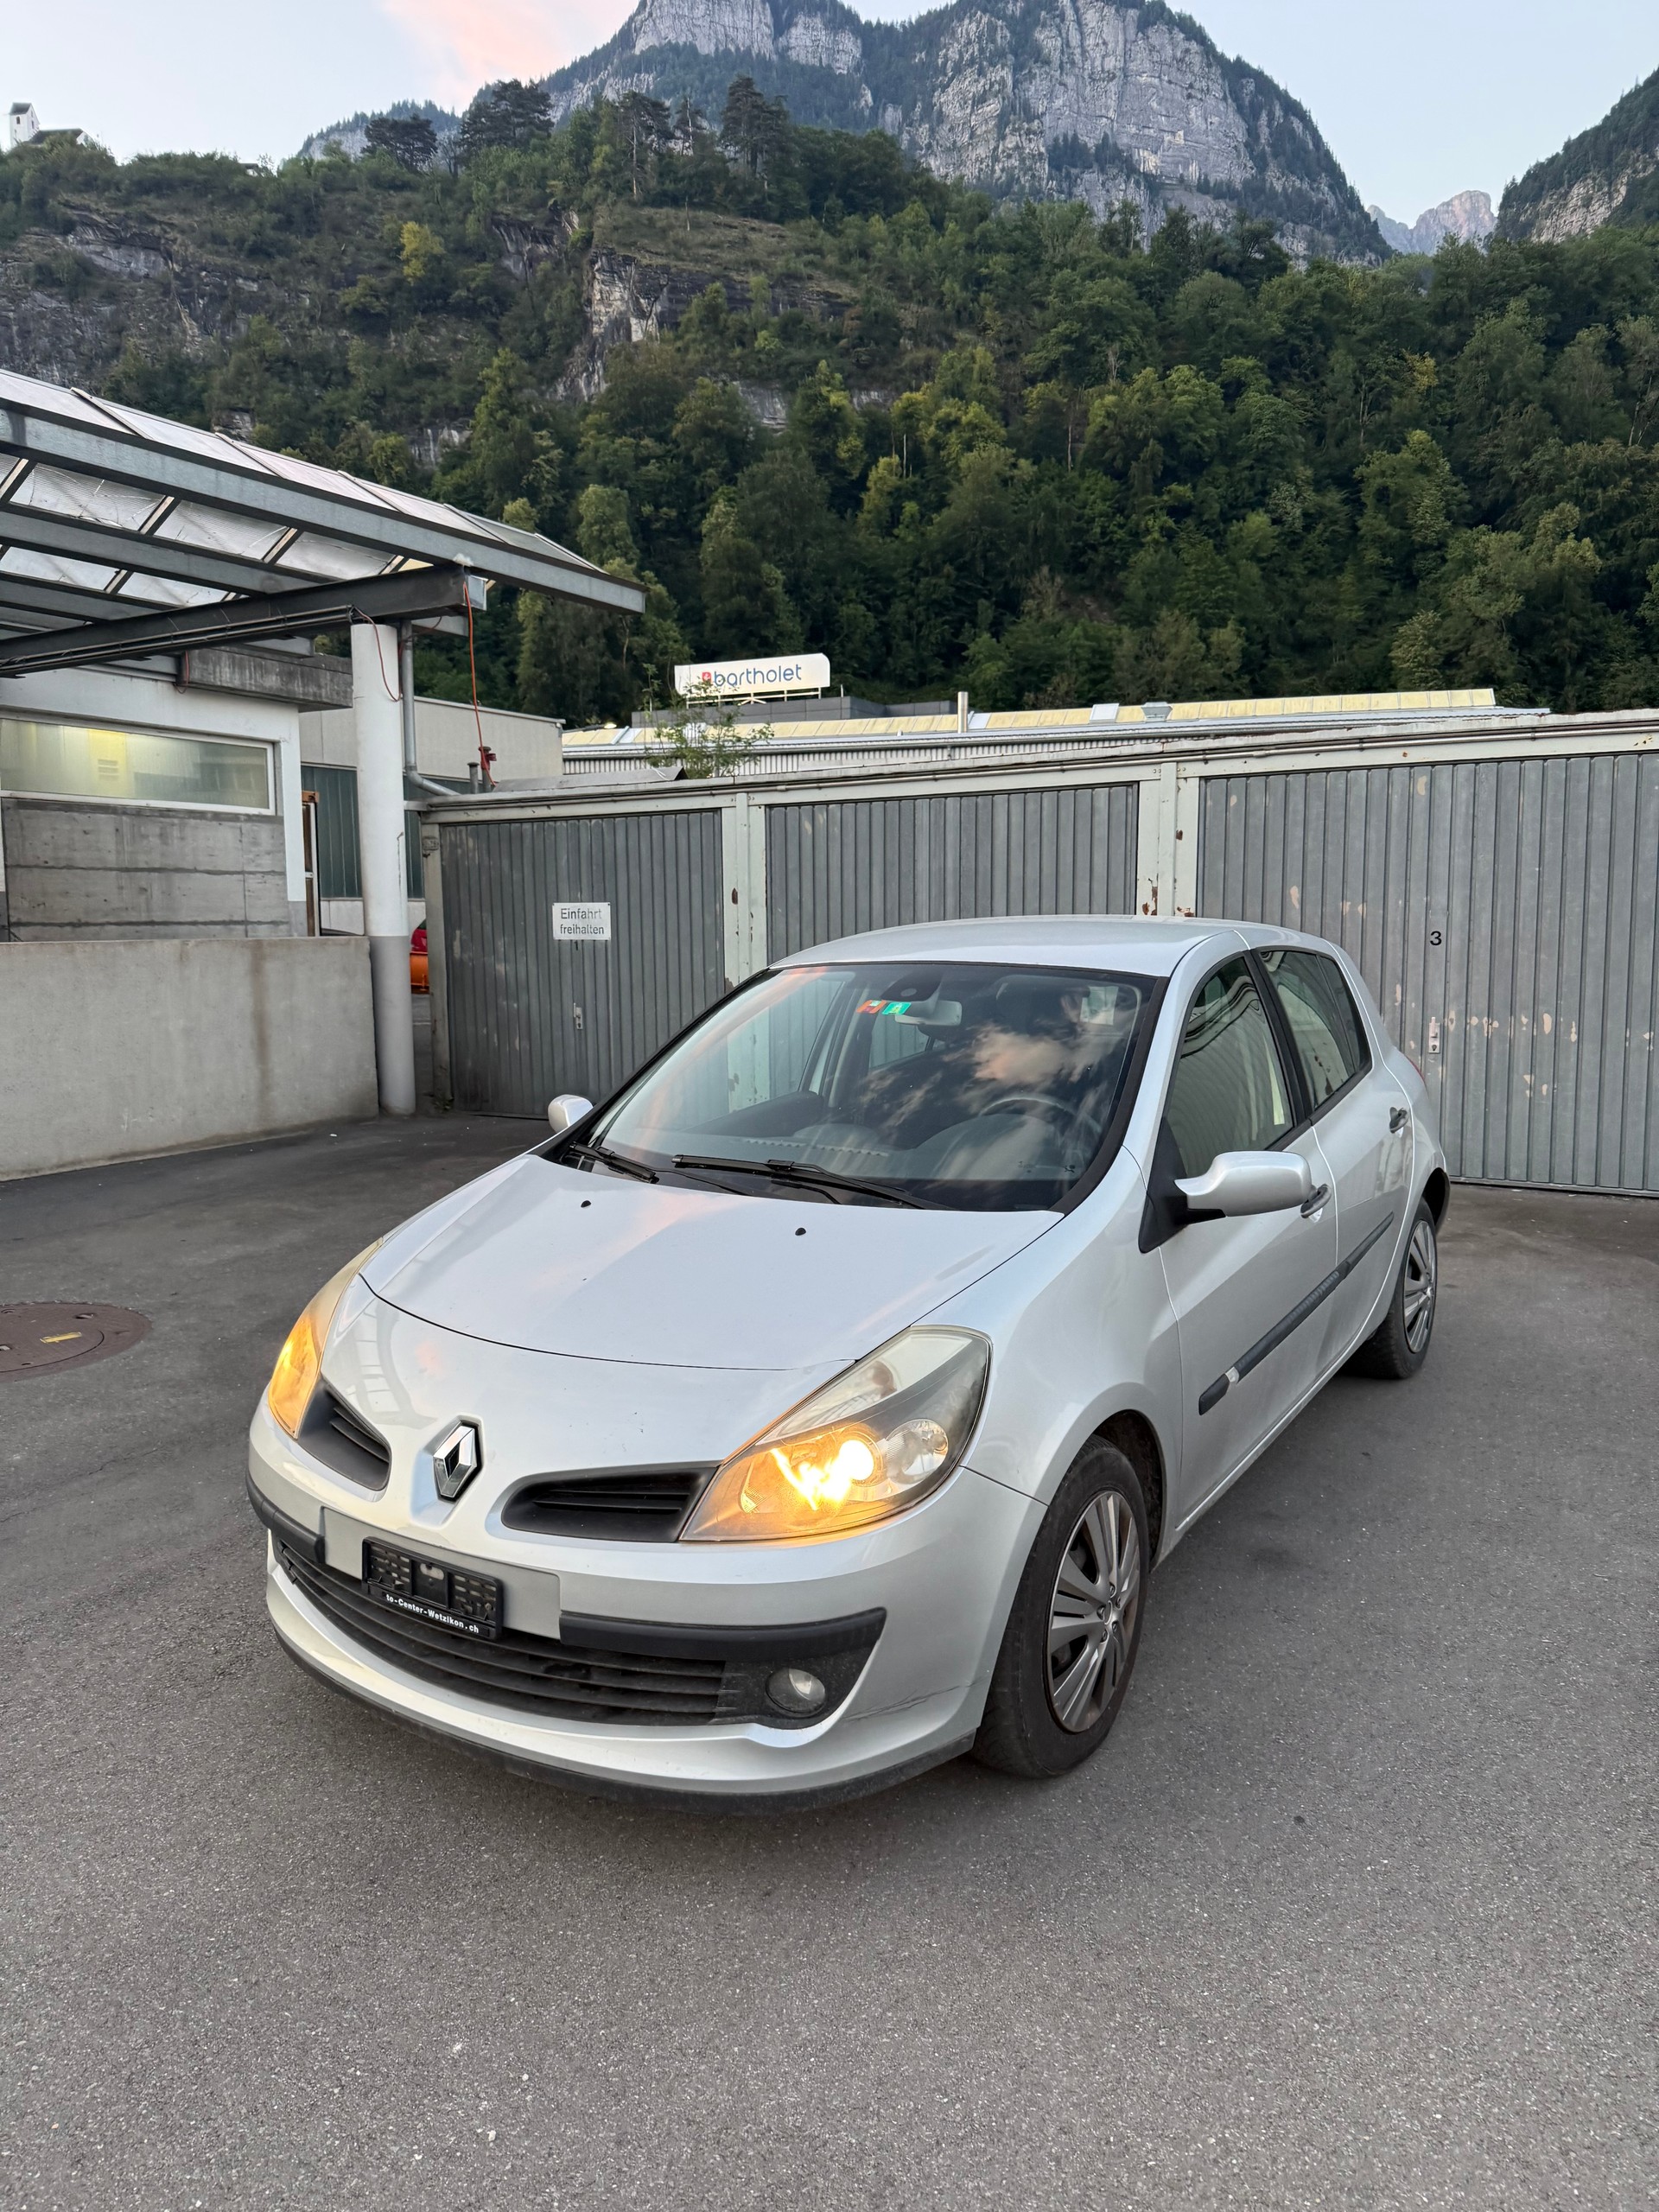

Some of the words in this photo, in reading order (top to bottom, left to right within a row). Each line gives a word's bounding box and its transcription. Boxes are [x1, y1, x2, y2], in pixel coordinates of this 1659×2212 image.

[713, 664, 802, 688] bartholet
[560, 908, 602, 919] Einfahrt
[560, 924, 605, 935] freihalten
[1429, 931, 1442, 946] 3
